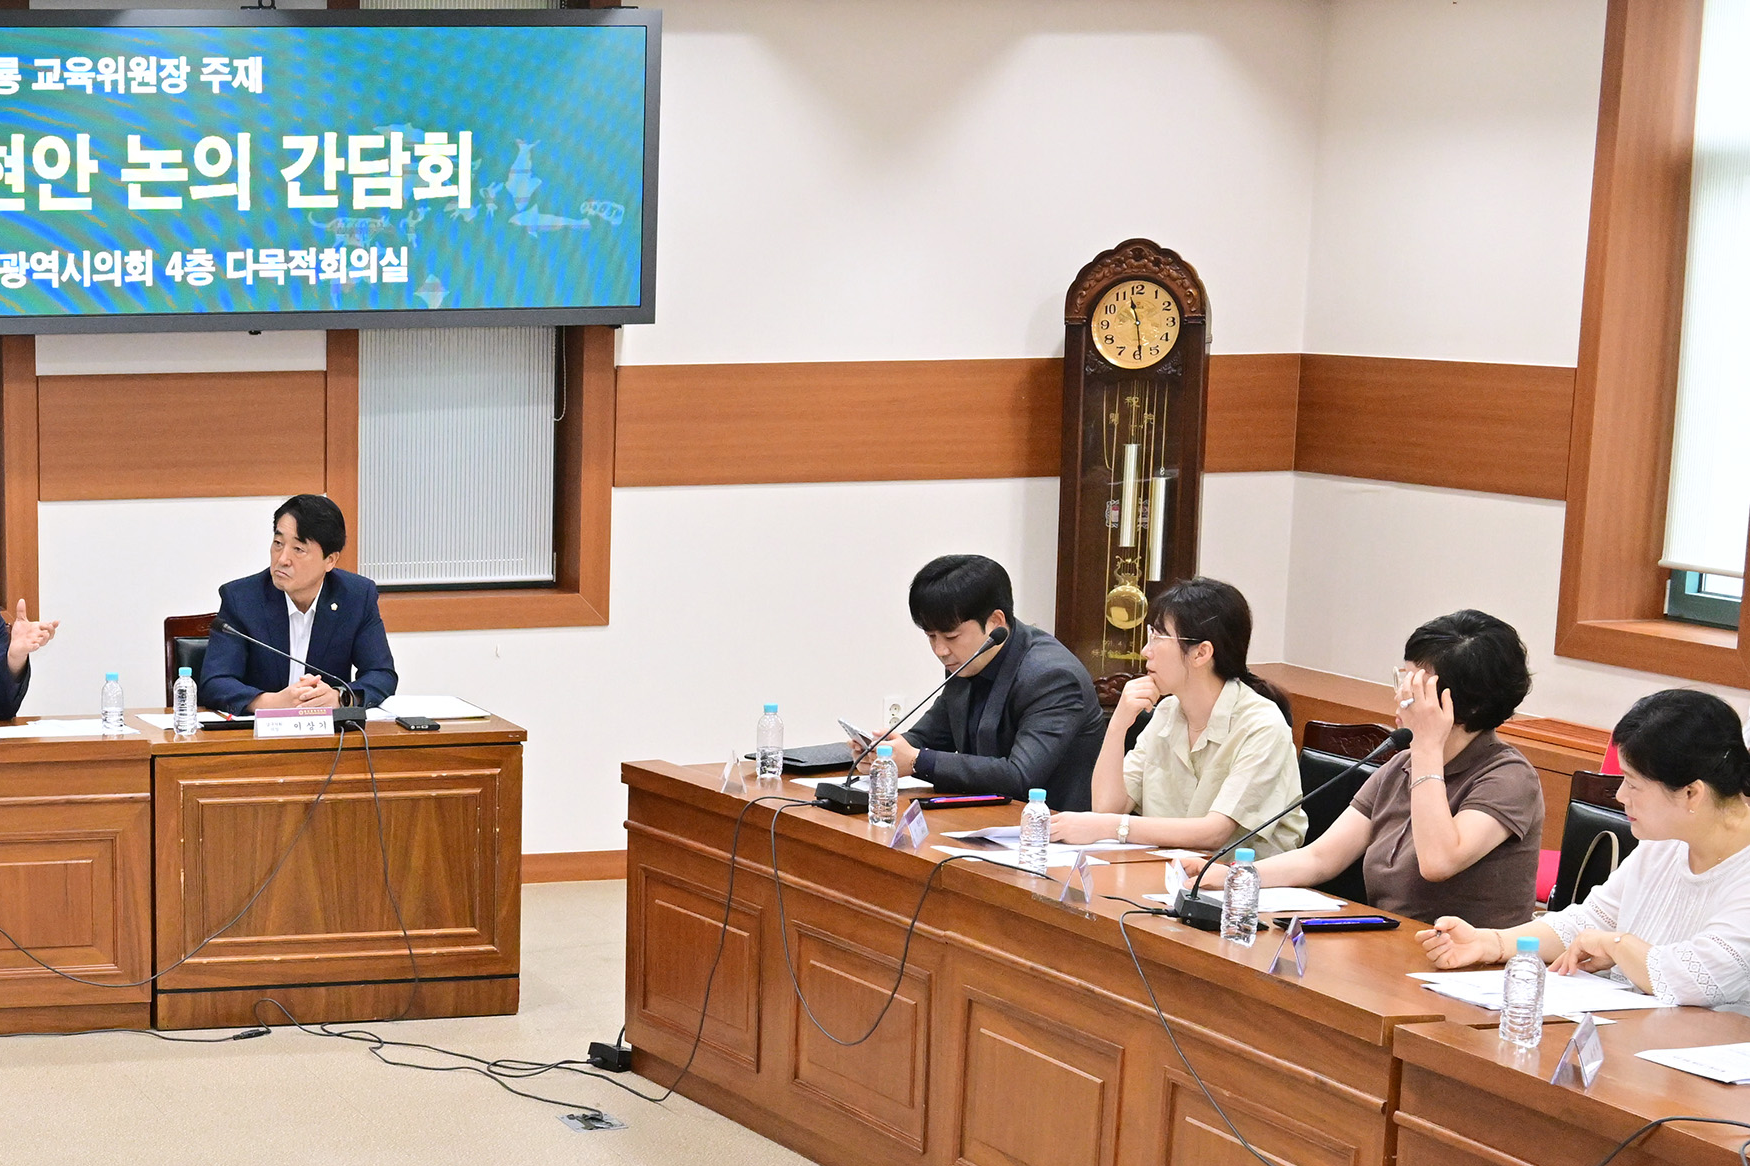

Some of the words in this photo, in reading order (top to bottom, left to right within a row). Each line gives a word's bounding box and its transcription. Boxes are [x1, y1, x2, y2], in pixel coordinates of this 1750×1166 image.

[31, 56, 191, 94] 교육위원장
[200, 56, 263, 94] 주재
[121, 132, 251, 211] 논의
[280, 131, 473, 210] 간담회
[165, 248, 216, 286] 4층
[226, 246, 408, 285] 다목적회의실
[1131, 285, 1145, 295] 12
[1154, 289, 1159, 299] 1
[1116, 291, 1127, 301] 11
[1105, 304, 1116, 314] 10
[1162, 301, 1172, 311] 2
[1100, 320, 1110, 330] 9
[1166, 317, 1176, 327] 3
[1104, 334, 1114, 344] 8
[1160, 332, 1170, 342] 4
[1116, 346, 1126, 356] 7
[1132, 350, 1142, 360] 6
[1149, 345, 1159, 356] 5
